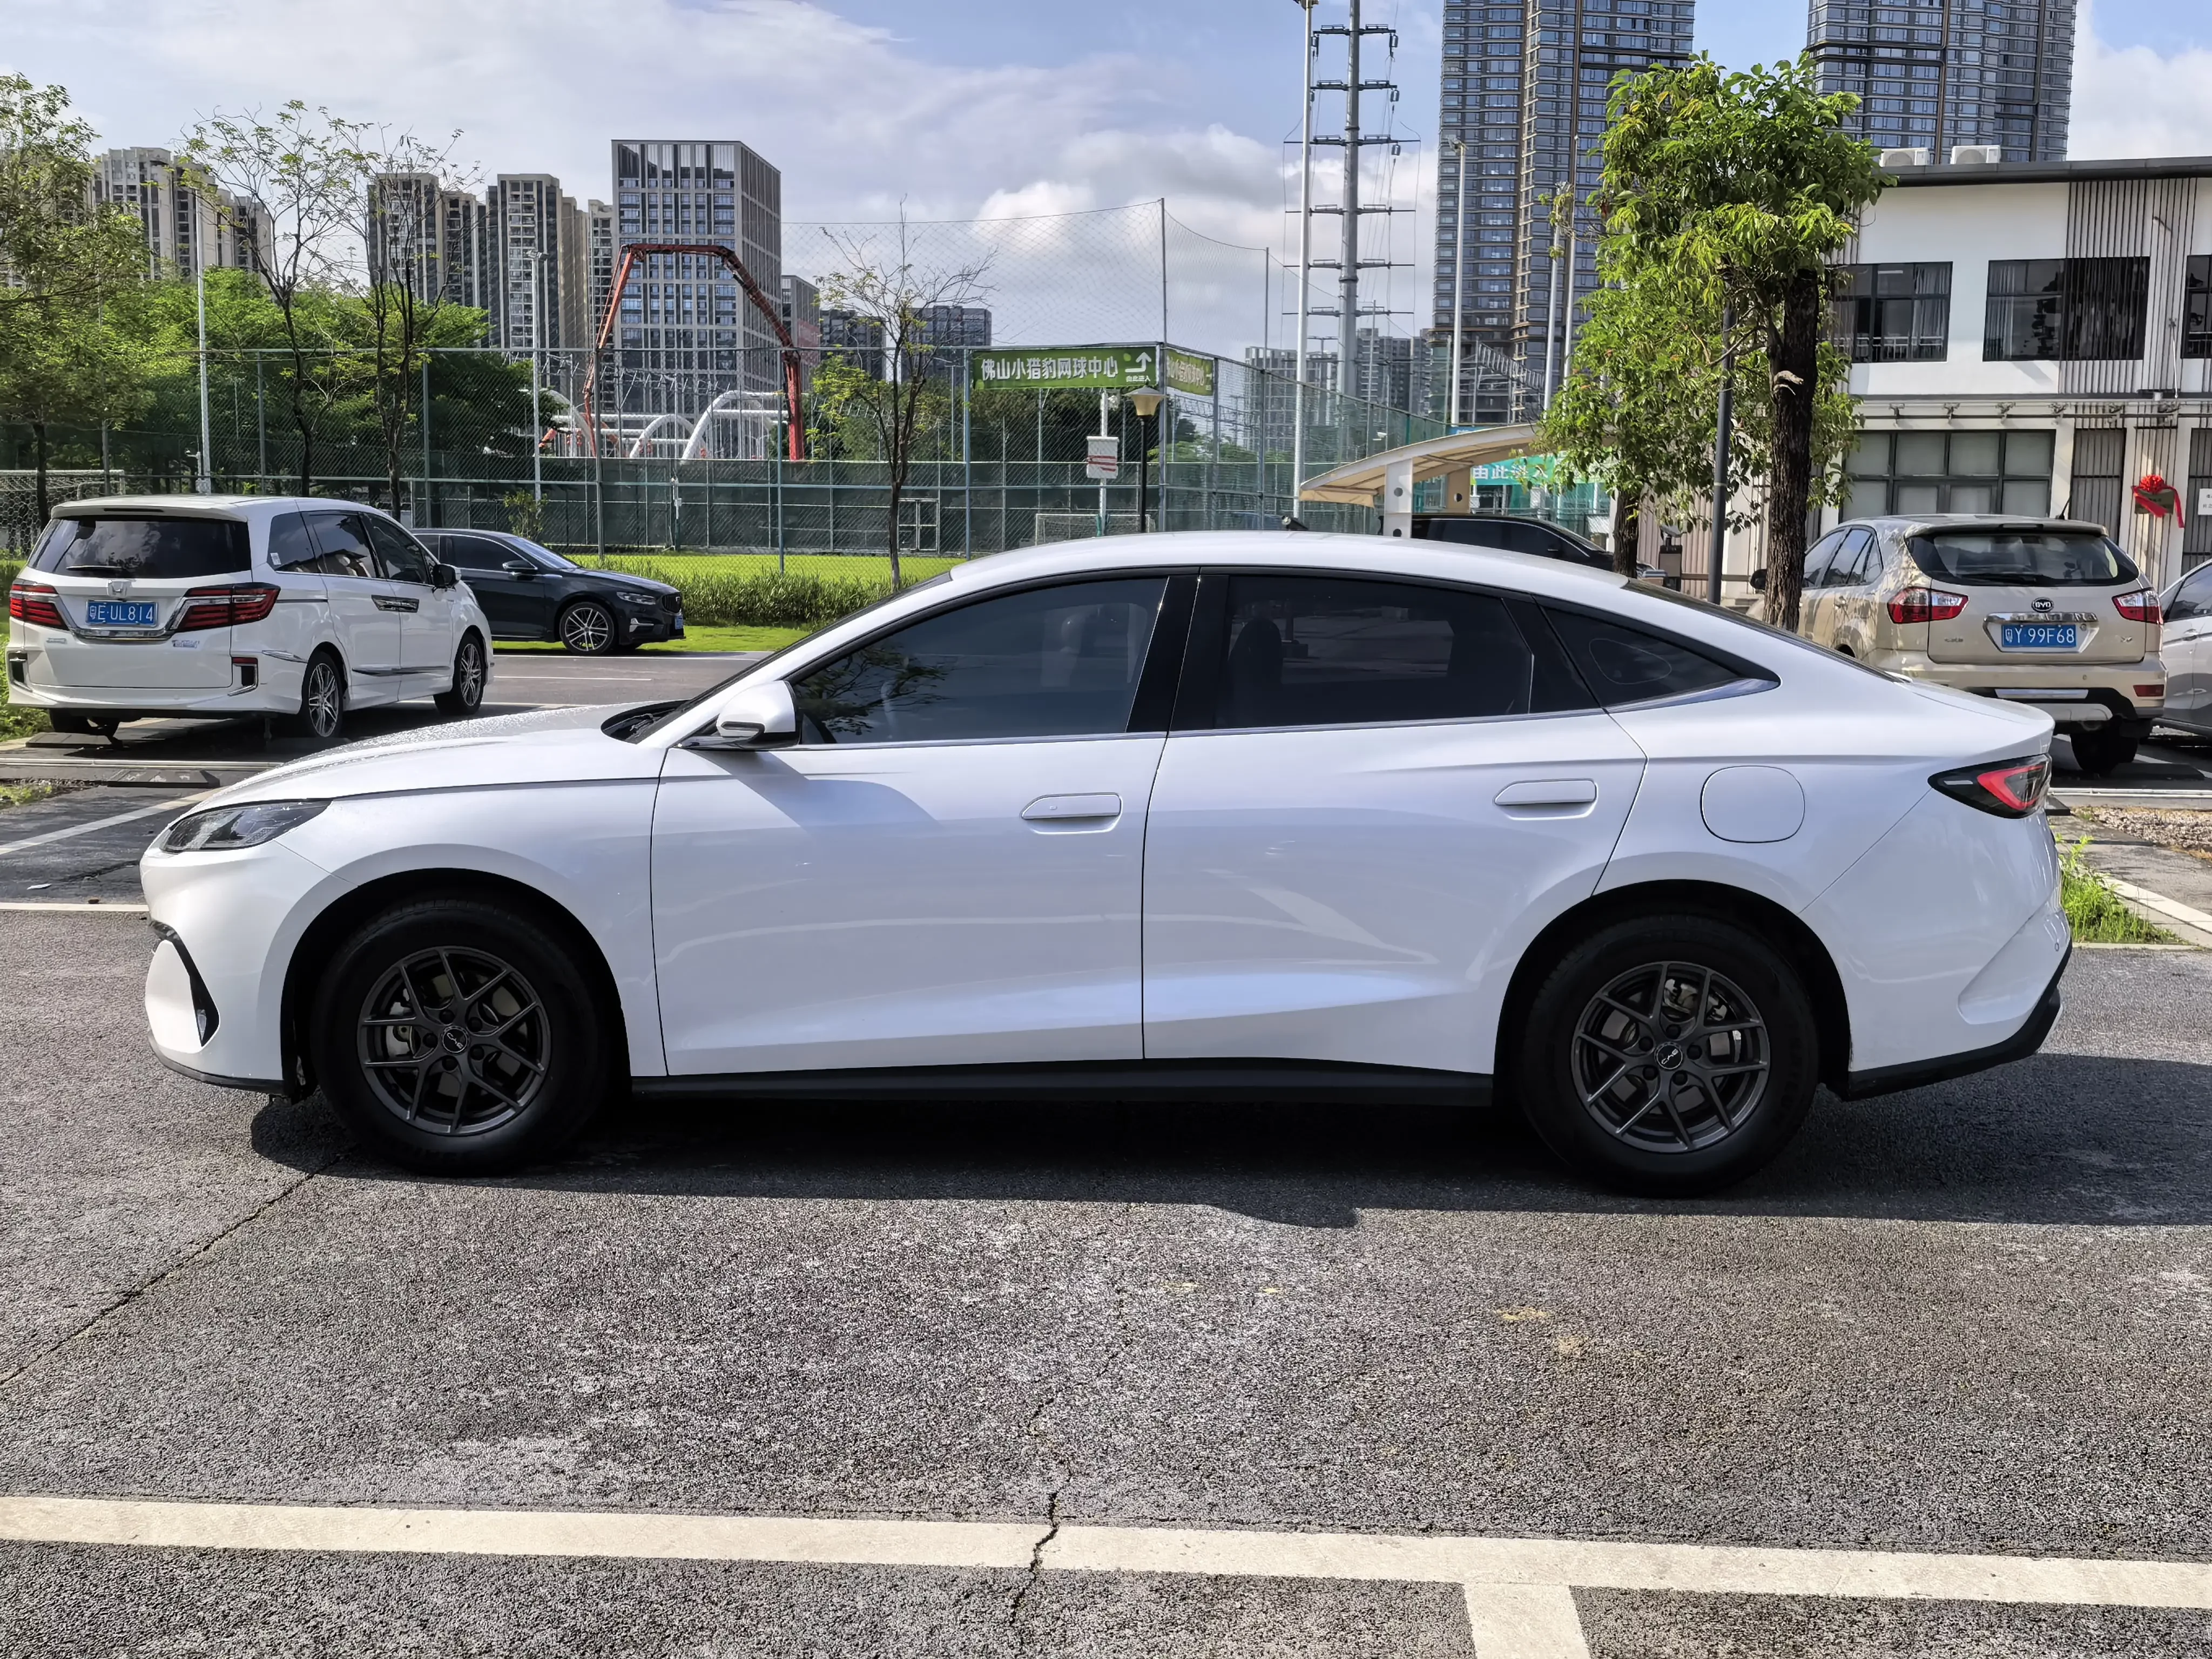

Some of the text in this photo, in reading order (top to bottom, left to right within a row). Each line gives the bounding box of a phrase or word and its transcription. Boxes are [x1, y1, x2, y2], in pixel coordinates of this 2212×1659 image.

[981, 356, 1118, 381] 佛山小猎豹网球中心
